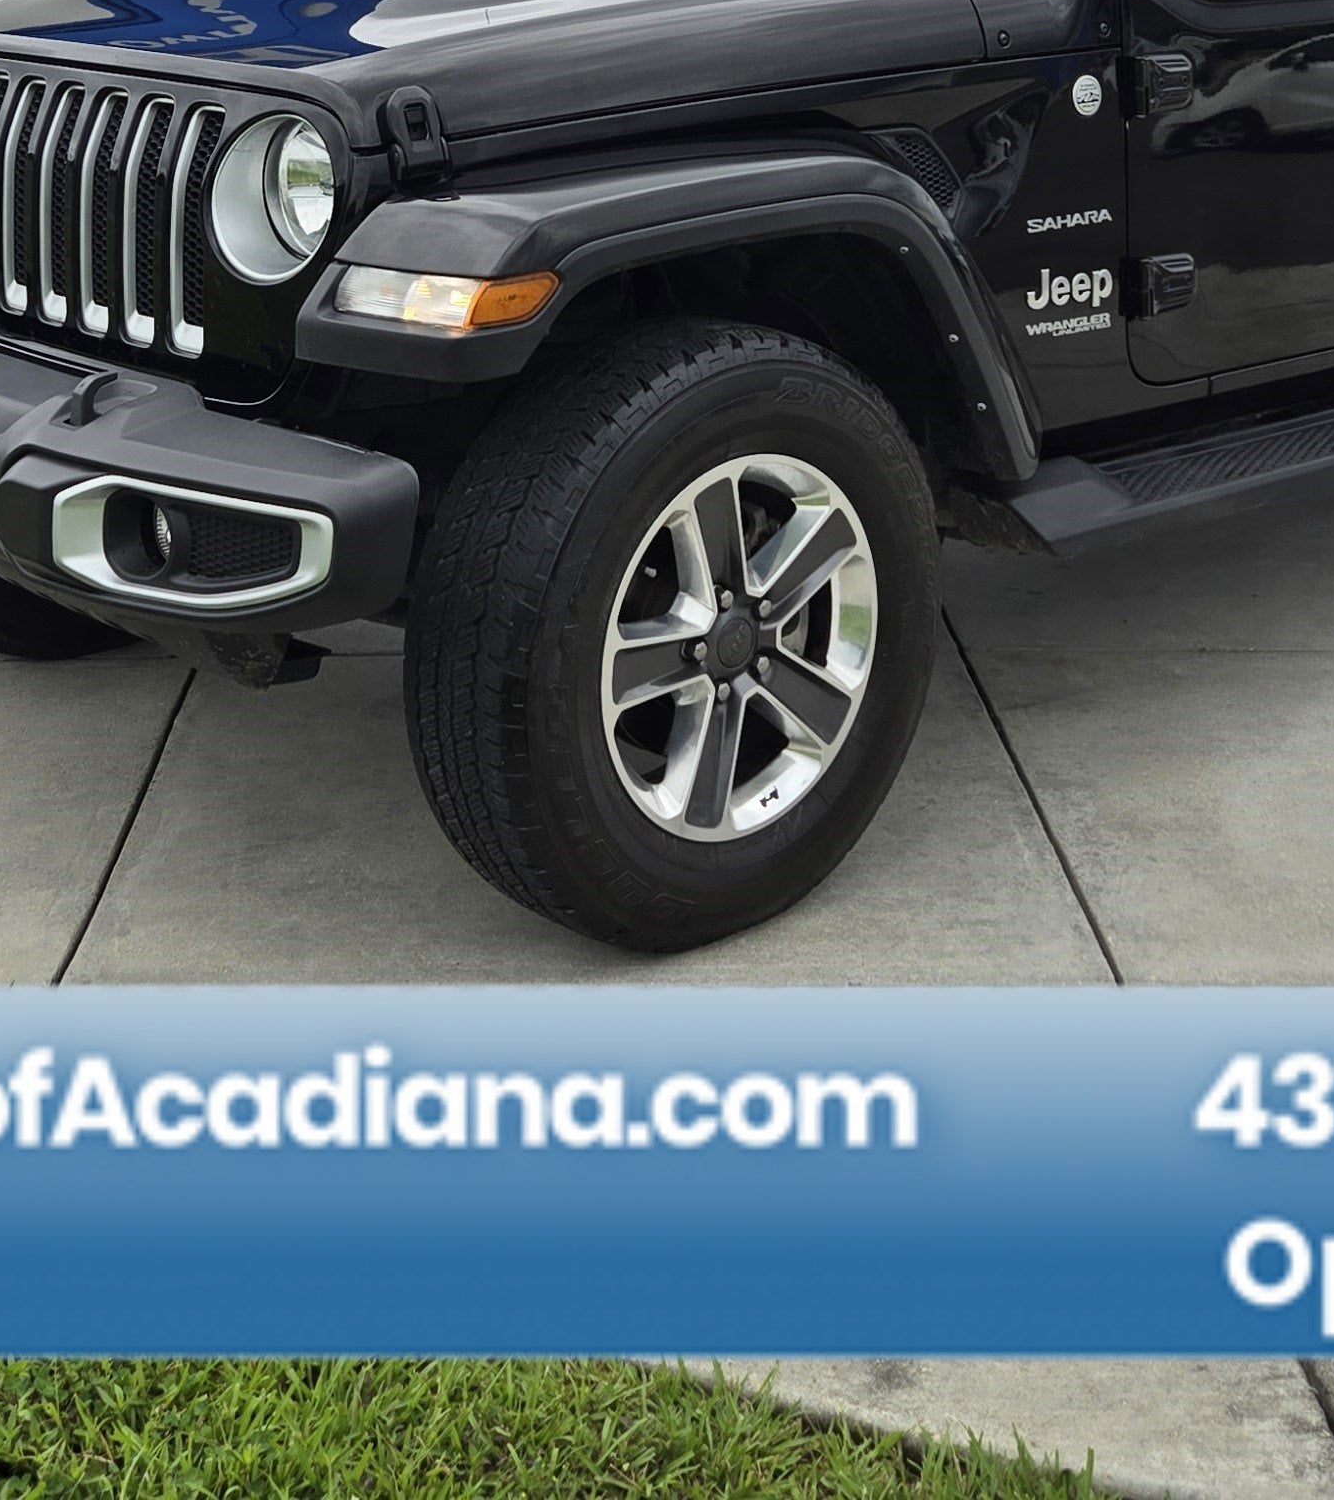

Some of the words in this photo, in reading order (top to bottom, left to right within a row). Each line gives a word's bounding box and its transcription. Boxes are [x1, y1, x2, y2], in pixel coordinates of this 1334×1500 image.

[1027, 209, 1112, 233] SAHARA
[1027, 268, 1113, 310] Jeep
[1026, 313, 1111, 336] WRANGLER
[1052, 322, 1111, 337] UNLIMITED
